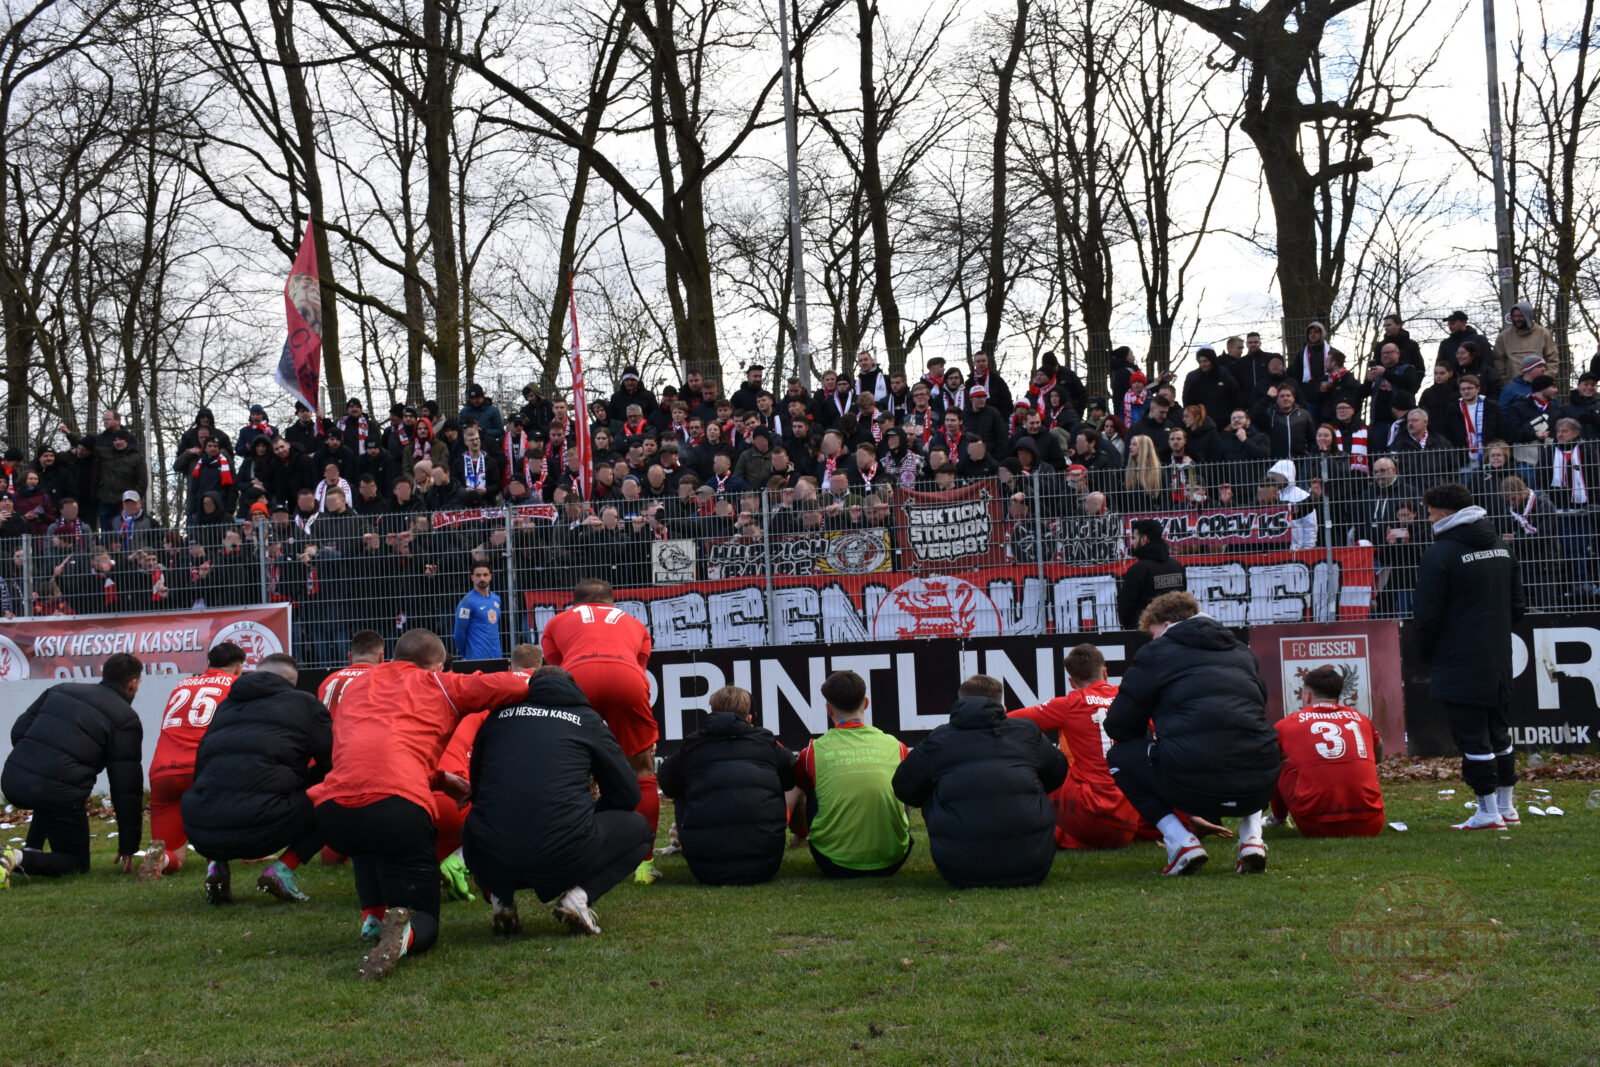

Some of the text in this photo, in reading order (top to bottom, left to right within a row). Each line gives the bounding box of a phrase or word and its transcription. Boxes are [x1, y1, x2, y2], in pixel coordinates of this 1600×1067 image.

[910, 501, 986, 525] SEKTION
[911, 518, 989, 542] STADION
[1129, 511, 1290, 543] YAL CREW KS
[915, 535, 988, 559] VERBOT
[234, 621, 255, 630] KSV
[572, 603, 626, 624] 17
[34, 629, 203, 657] KSV HESSEN KASSEL
[1292, 641, 1356, 658] FC GIESSEN
[162, 686, 222, 730] 25
[498, 707, 582, 726] KSV HESSEN KASSEL
[1298, 711, 1362, 723] SPRINGFELD
[1310, 720, 1367, 760] 31
